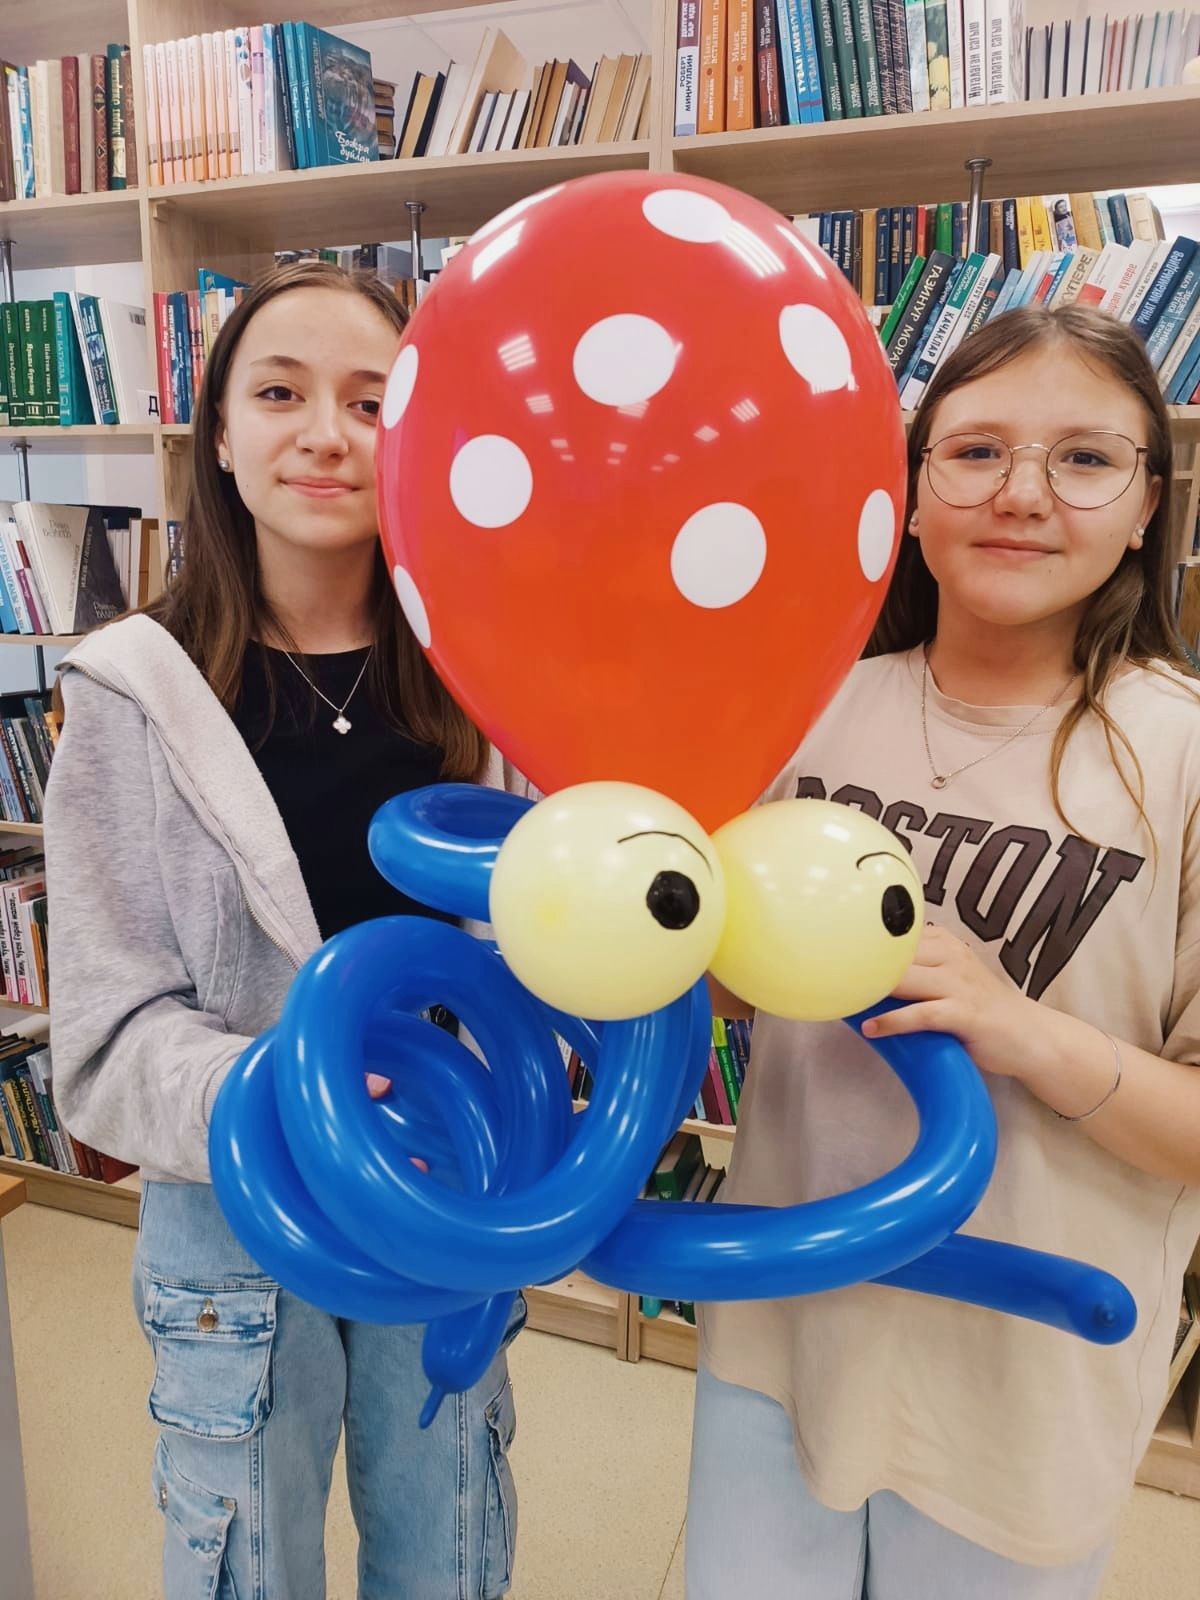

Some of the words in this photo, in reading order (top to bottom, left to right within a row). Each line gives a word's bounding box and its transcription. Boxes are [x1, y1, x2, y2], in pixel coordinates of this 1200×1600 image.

[910, 264, 944, 322] ГАЗИНУР
[1137, 301, 1158, 325] РИНАТ
[928, 311, 955, 358] КАЧАКЛАР
[148, 395, 160, 417] Д
